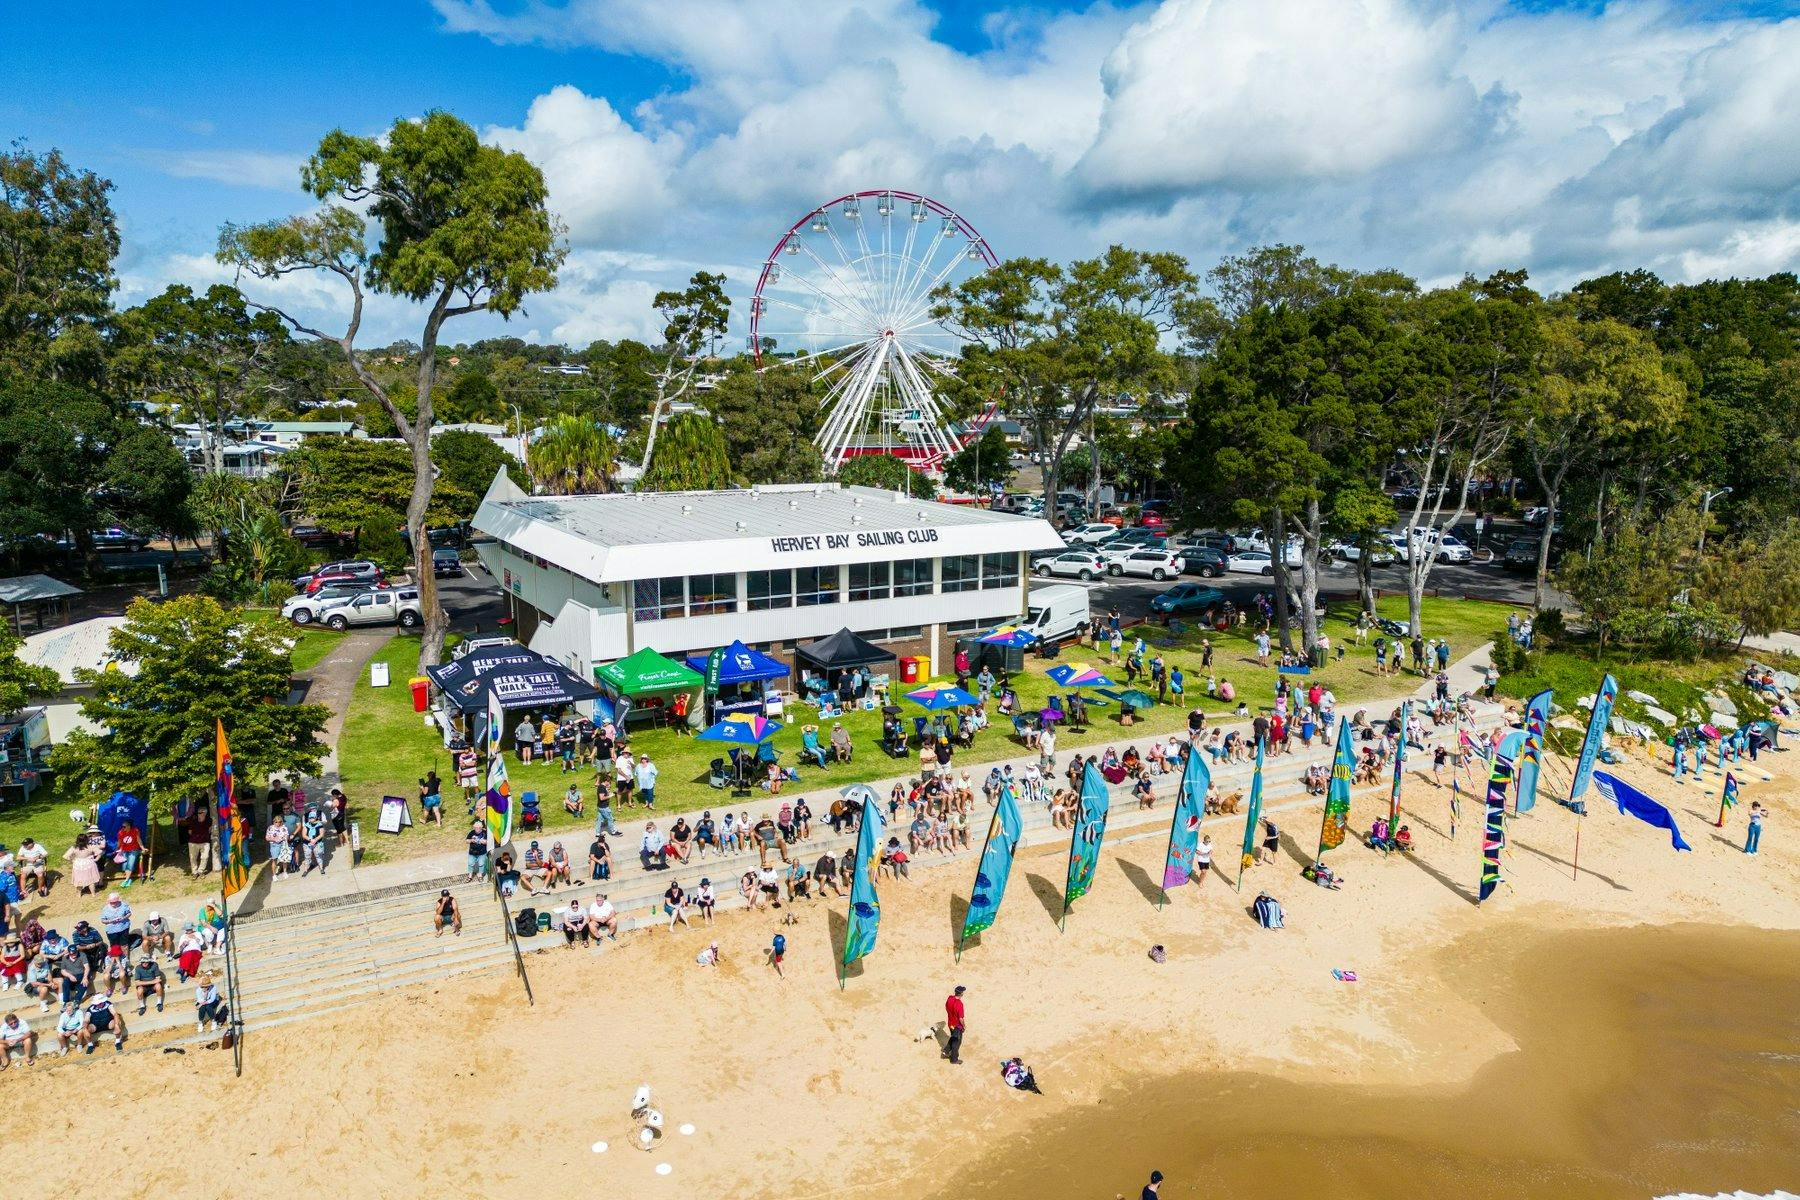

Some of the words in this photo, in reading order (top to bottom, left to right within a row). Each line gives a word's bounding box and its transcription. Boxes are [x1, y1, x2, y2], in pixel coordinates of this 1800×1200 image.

[771, 536, 820, 553] HERVEY
[826, 535, 850, 549] BAY
[857, 531, 905, 547] SAILING
[908, 529, 938, 543] CLUB
[472, 657, 501, 667] MEN'S
[493, 674, 524, 685] MEN'S
[528, 674, 553, 684] TALK
[499, 682, 527, 692] WALK
